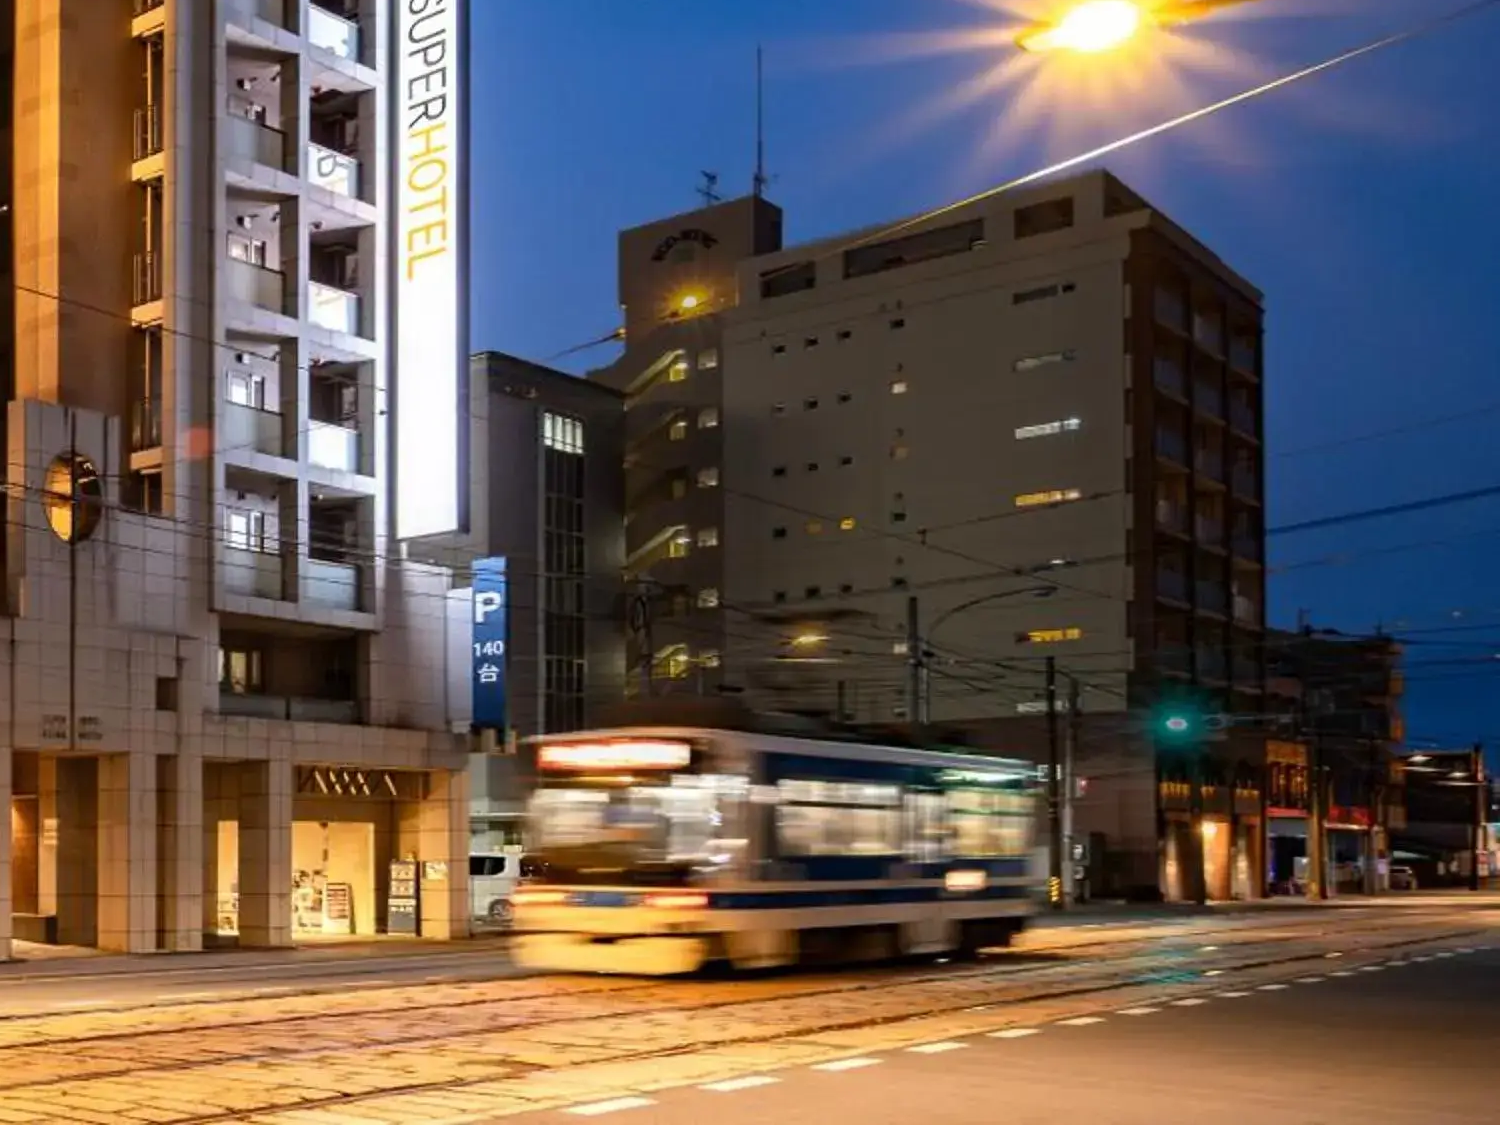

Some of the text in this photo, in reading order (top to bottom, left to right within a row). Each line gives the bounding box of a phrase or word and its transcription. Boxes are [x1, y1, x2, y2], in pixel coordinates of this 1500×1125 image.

[475, 591, 501, 623] P
[473, 640, 503, 657] 140
[477, 662, 500, 683] 台
